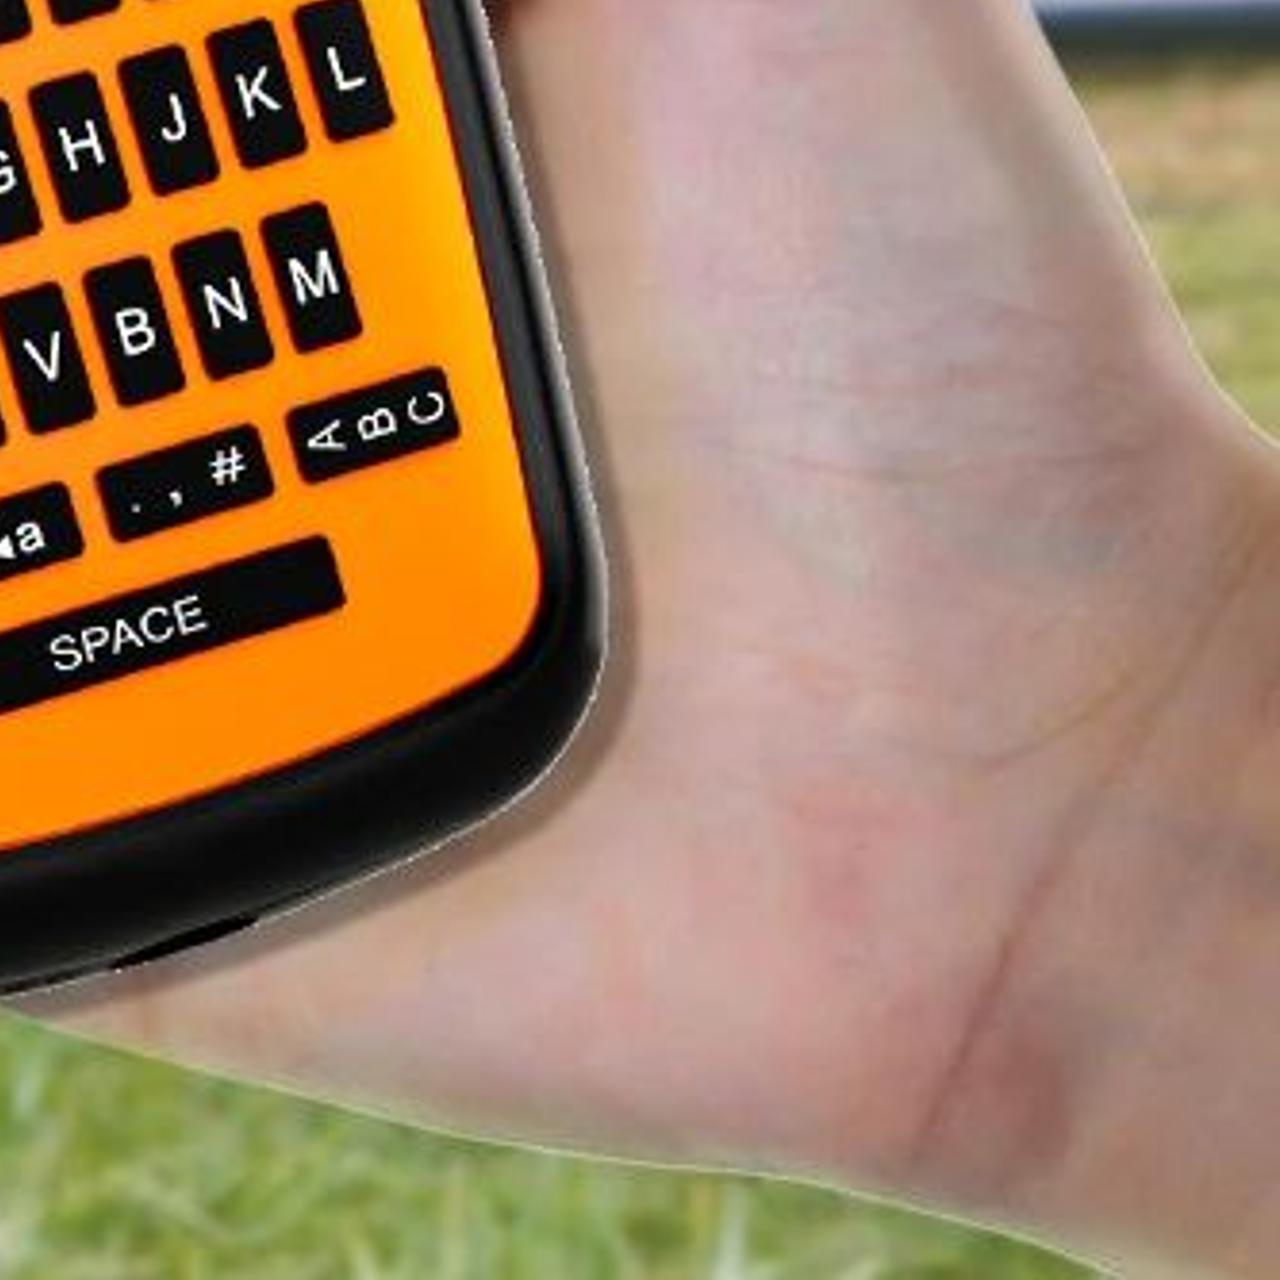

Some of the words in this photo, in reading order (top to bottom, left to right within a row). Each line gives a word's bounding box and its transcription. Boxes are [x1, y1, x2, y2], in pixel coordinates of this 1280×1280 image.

[234, 64, 283, 120] K
[325, 45, 368, 92] L
[160, 92, 188, 143] J
[57, 118, 107, 173] H
[202, 275, 249, 330] N
[287, 248, 341, 306] M
[22, 329, 62, 383] V
[114, 306, 157, 357] B
[48, 593, 208, 672] SPACE
